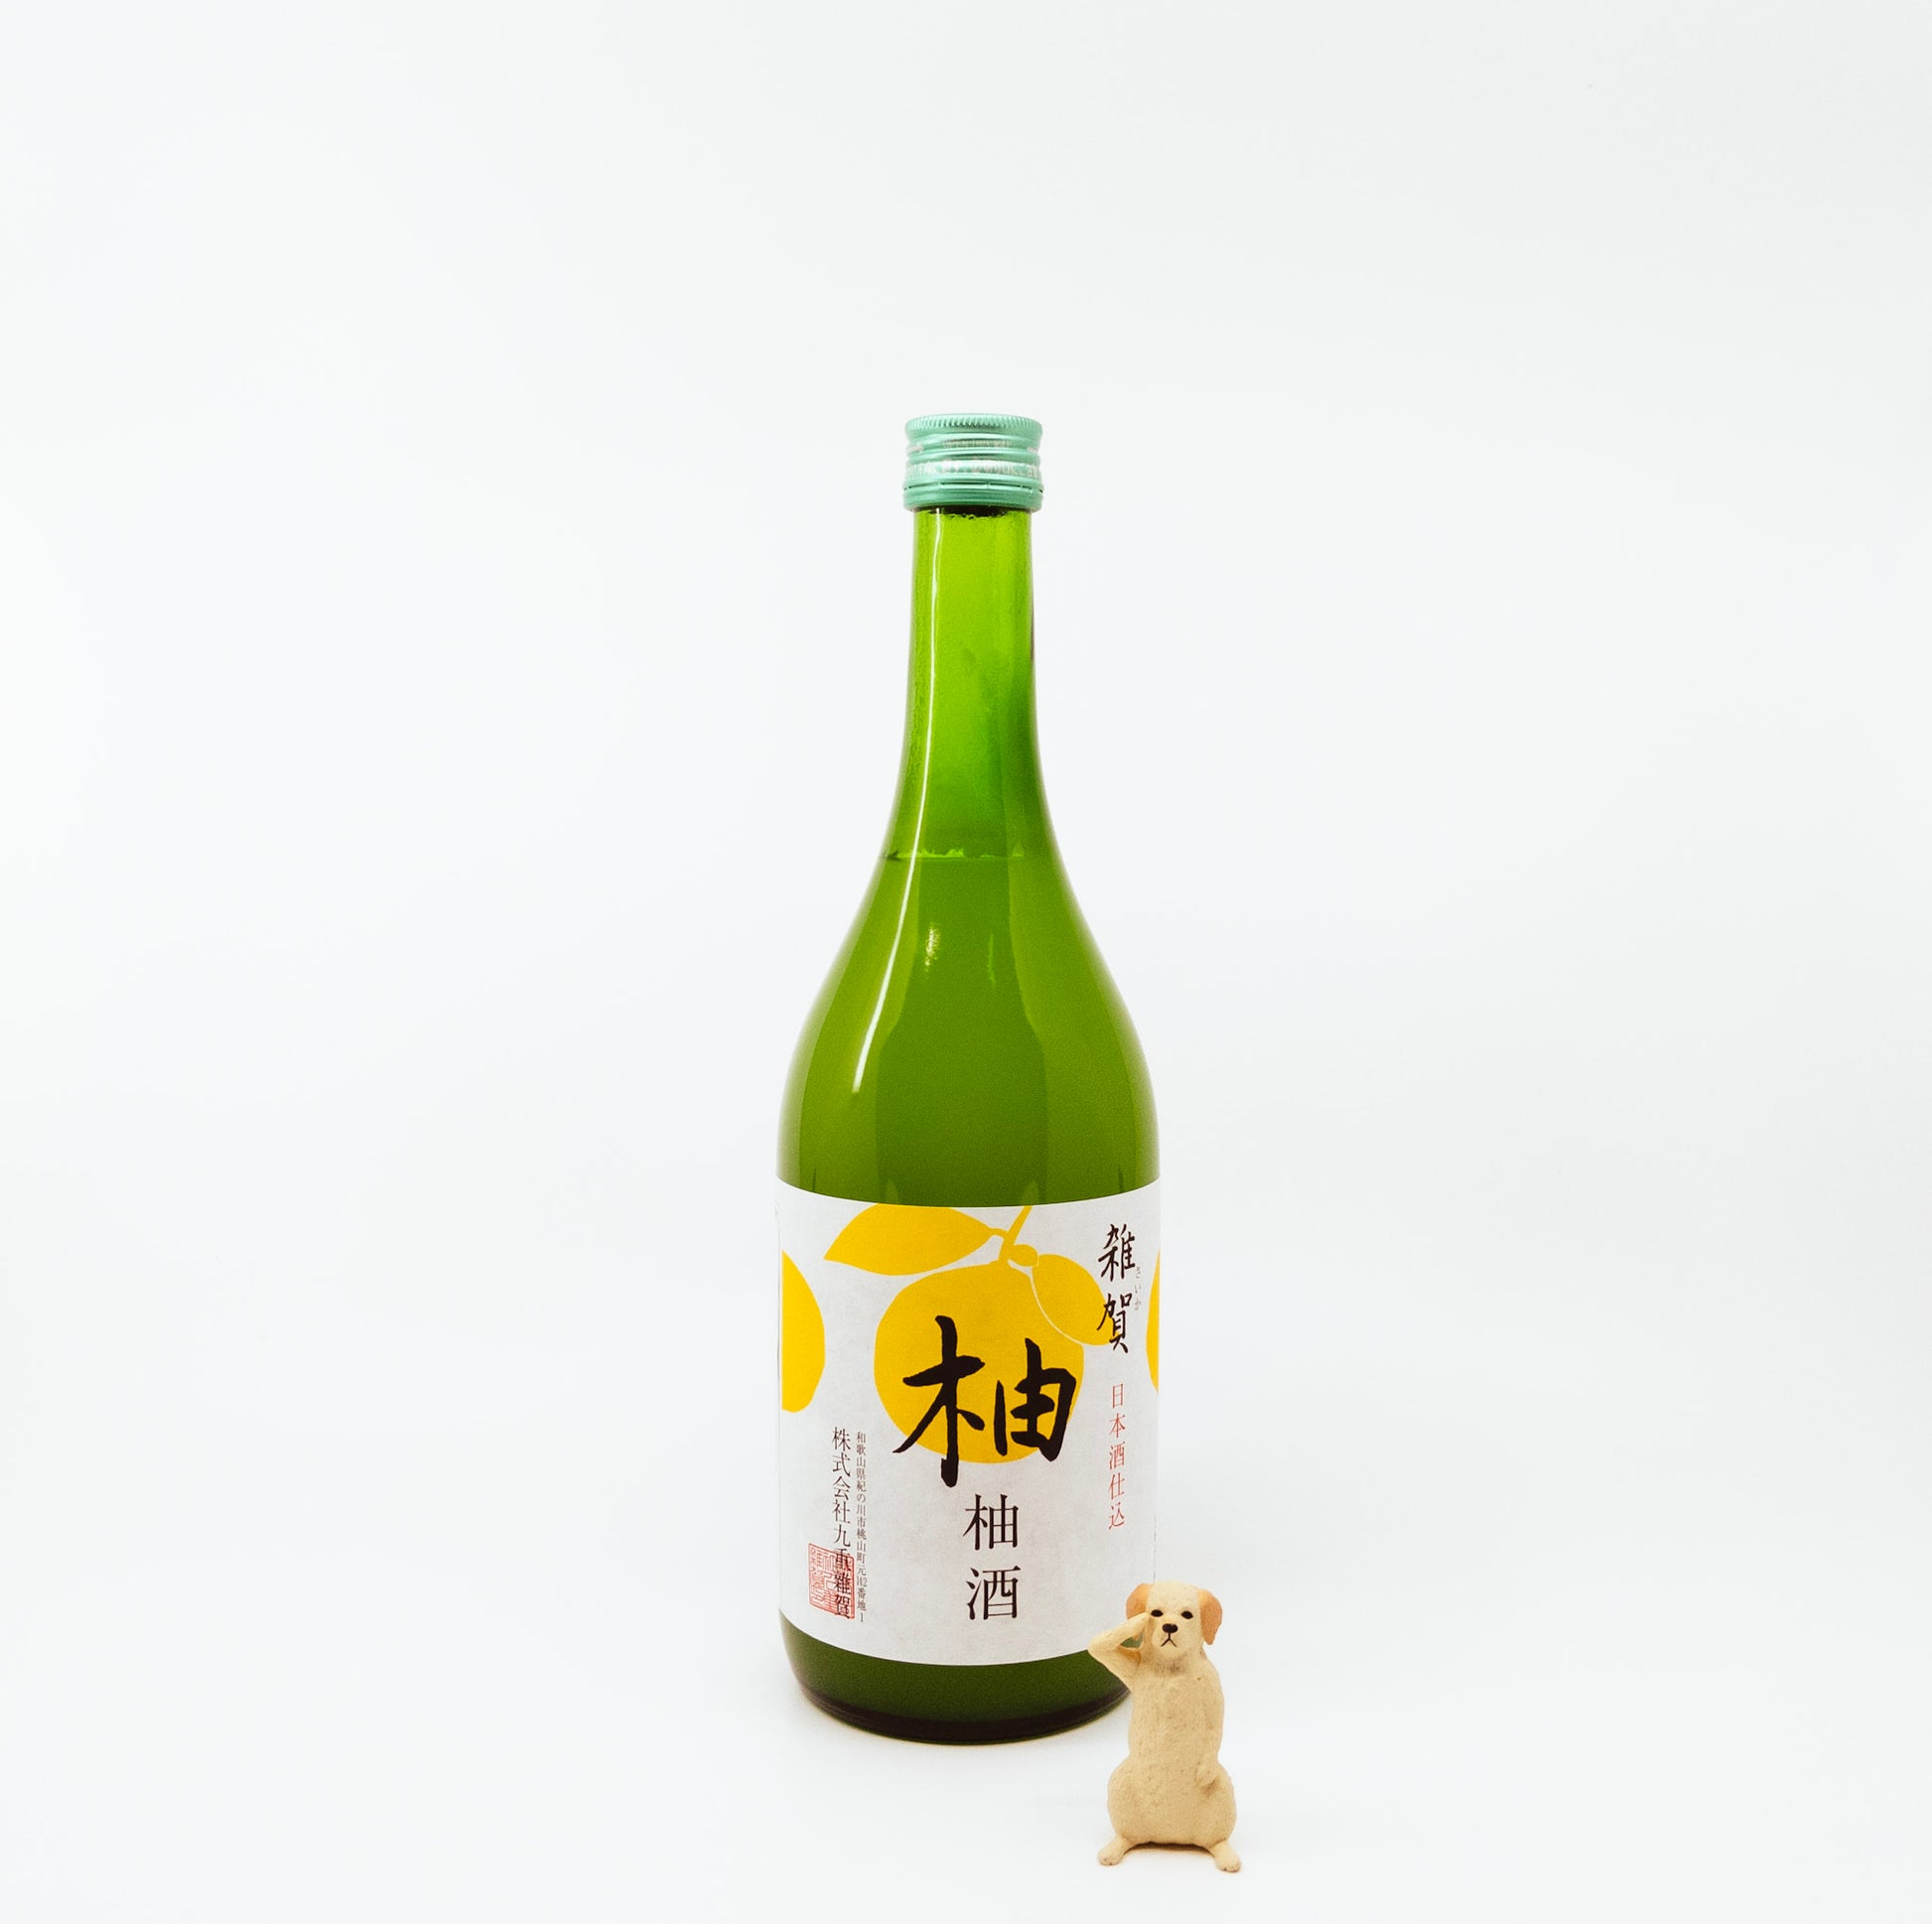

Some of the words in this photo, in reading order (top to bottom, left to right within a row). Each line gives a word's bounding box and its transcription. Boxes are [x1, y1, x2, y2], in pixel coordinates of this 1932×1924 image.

[893, 1315, 1077, 1487] 柚
[1108, 1383, 1126, 1530] 日本酒仕込
[962, 1494, 1022, 1621] 柚酒
